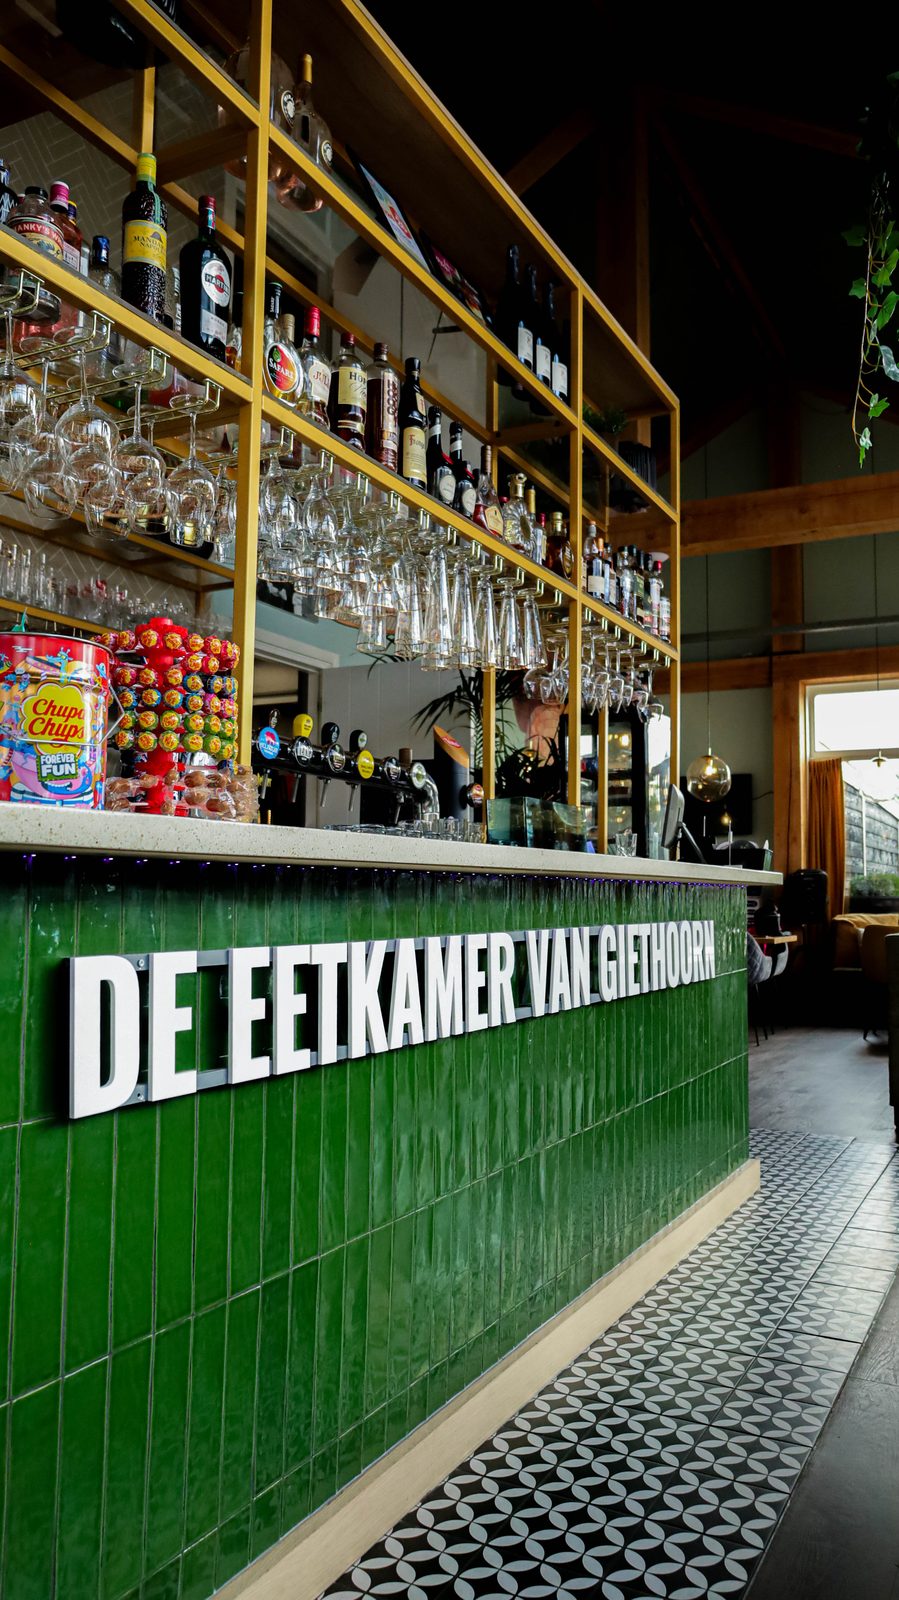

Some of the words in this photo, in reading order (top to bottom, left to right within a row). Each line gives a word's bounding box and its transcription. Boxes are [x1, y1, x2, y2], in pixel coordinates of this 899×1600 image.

[268, 357, 294, 379] SAFARI
[32, 699, 85, 722] Chupa
[28, 716, 85, 744] Chups
[40, 753, 75, 764] FOREVER
[41, 763, 76, 777] FUN
[69, 951, 197, 1119] DE
[228, 932, 517, 1085] EETKAMER
[523, 927, 591, 1018] VAN
[598, 920, 715, 1003] GIETHOORN
